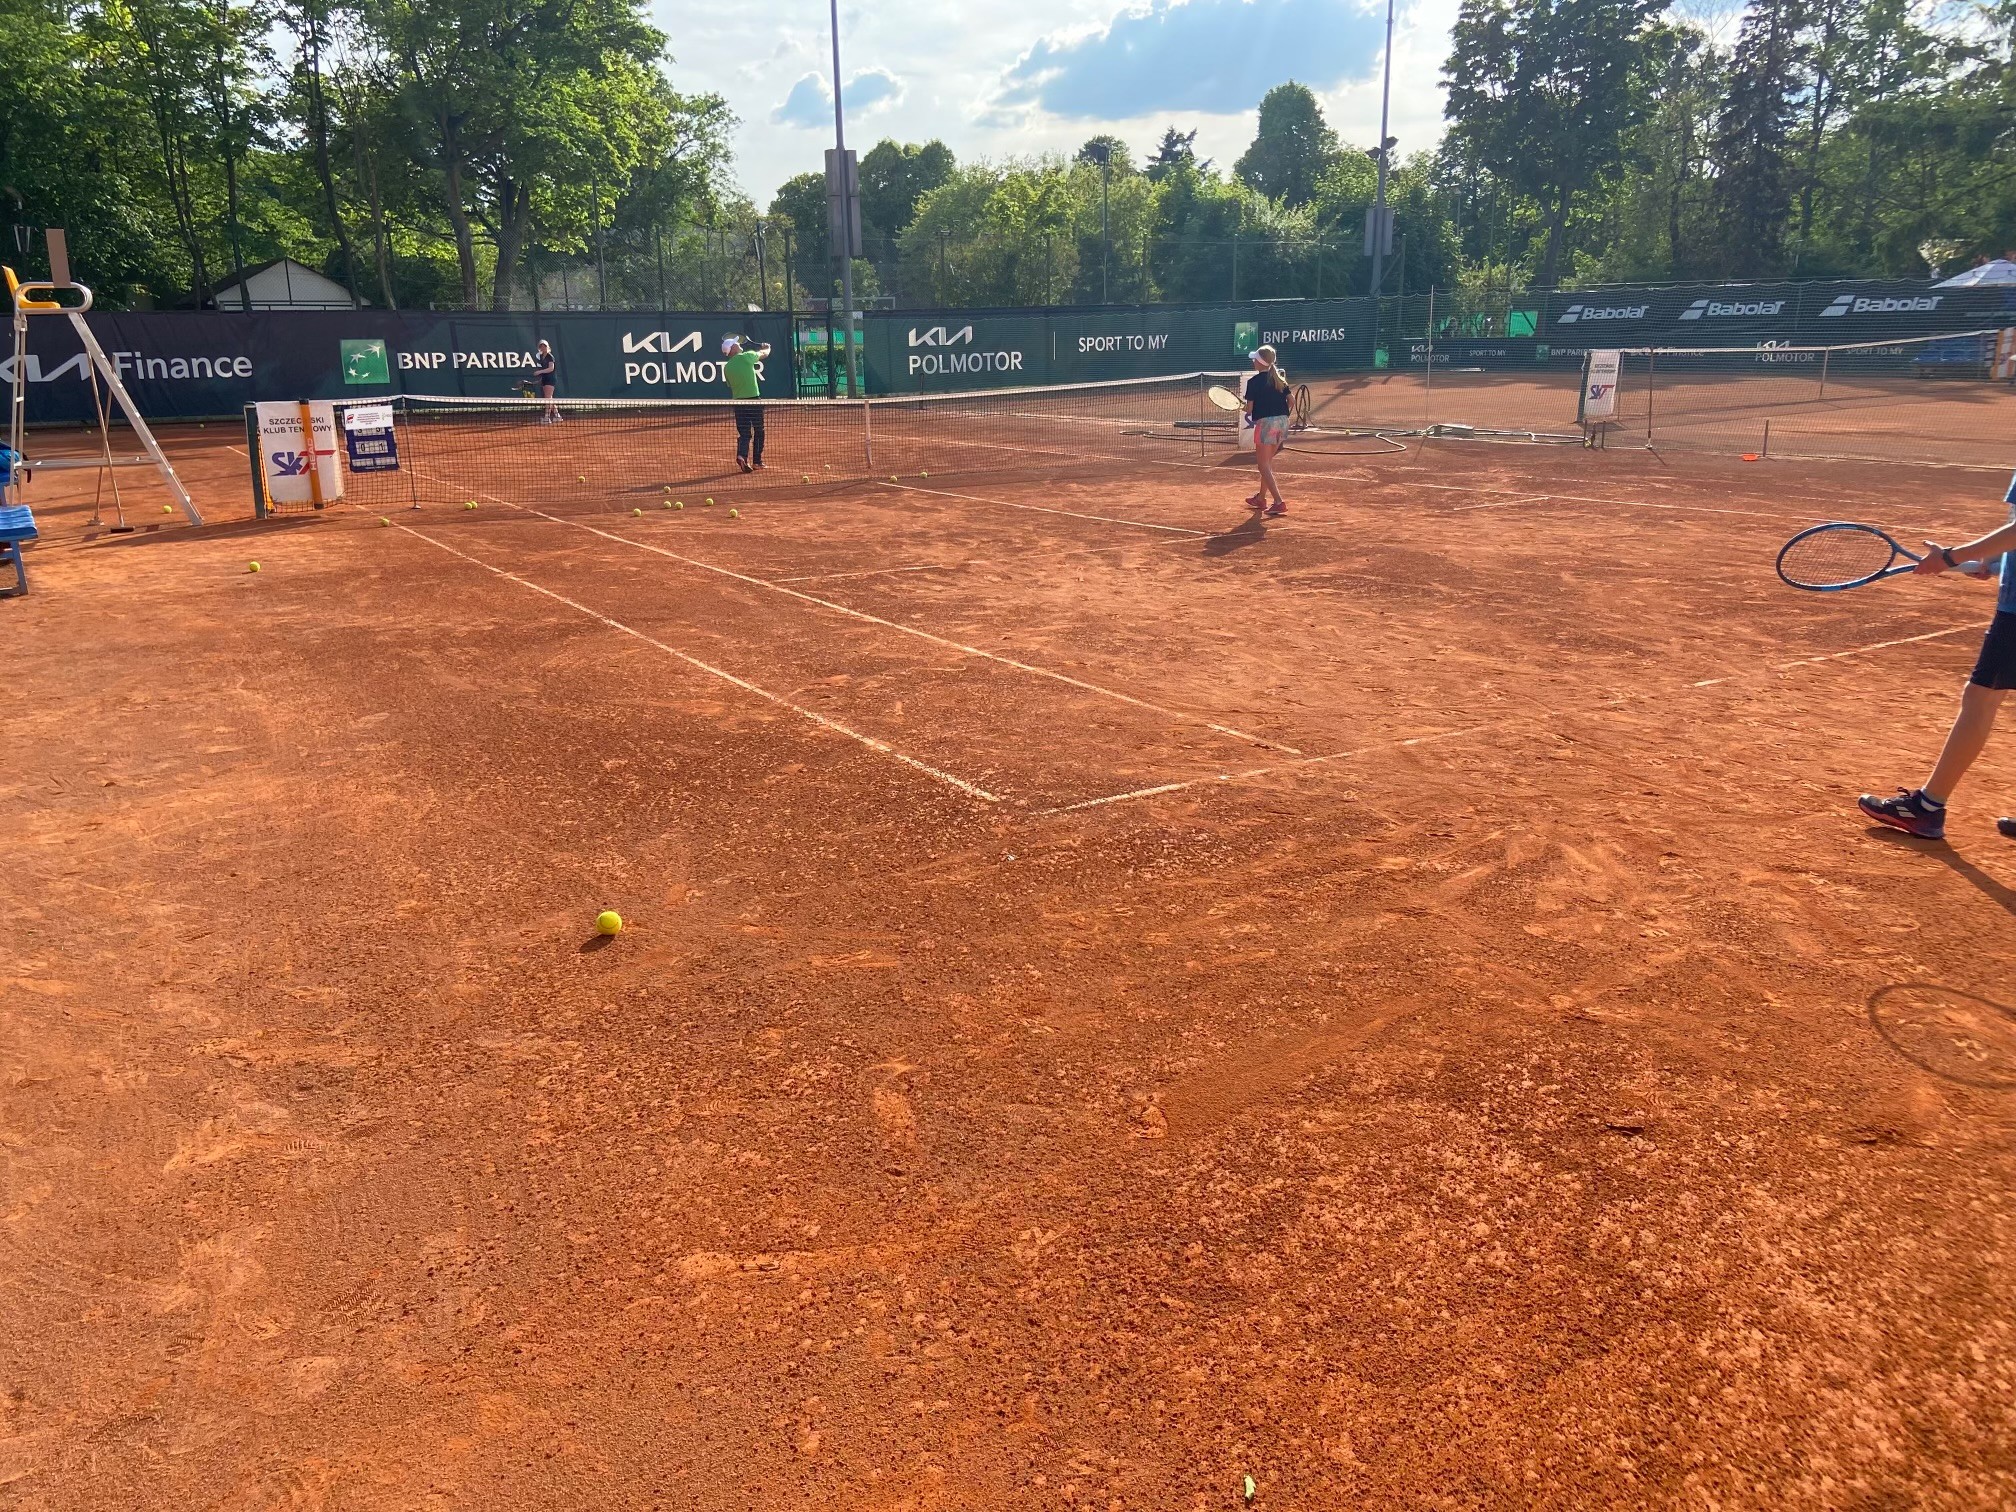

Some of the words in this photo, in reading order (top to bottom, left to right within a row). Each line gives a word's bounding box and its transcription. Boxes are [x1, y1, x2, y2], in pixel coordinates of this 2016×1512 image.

[622, 331, 703, 354] KIA
[908, 325, 973, 347] KIA
[1078, 335, 1123, 353] SPORT
[1124, 335, 1145, 351] TO
[1148, 334, 1169, 350] MY
[1263, 330, 1290, 344] BNP
[1292, 328, 1345, 343] PARIBAS
[397, 352, 446, 370] BNP
[1550, 348, 1566, 356] BNP
[1755, 352, 1815, 362] POLMOTOR
[112, 351, 253, 380] Finance
[909, 351, 1023, 375] POLMOTOR
[624, 361, 766, 385] POLMOTR
[263, 426, 287, 434] KLUB
[288, 425, 332, 434] TENOWY
[269, 416, 325, 426] SZCZECSKI
